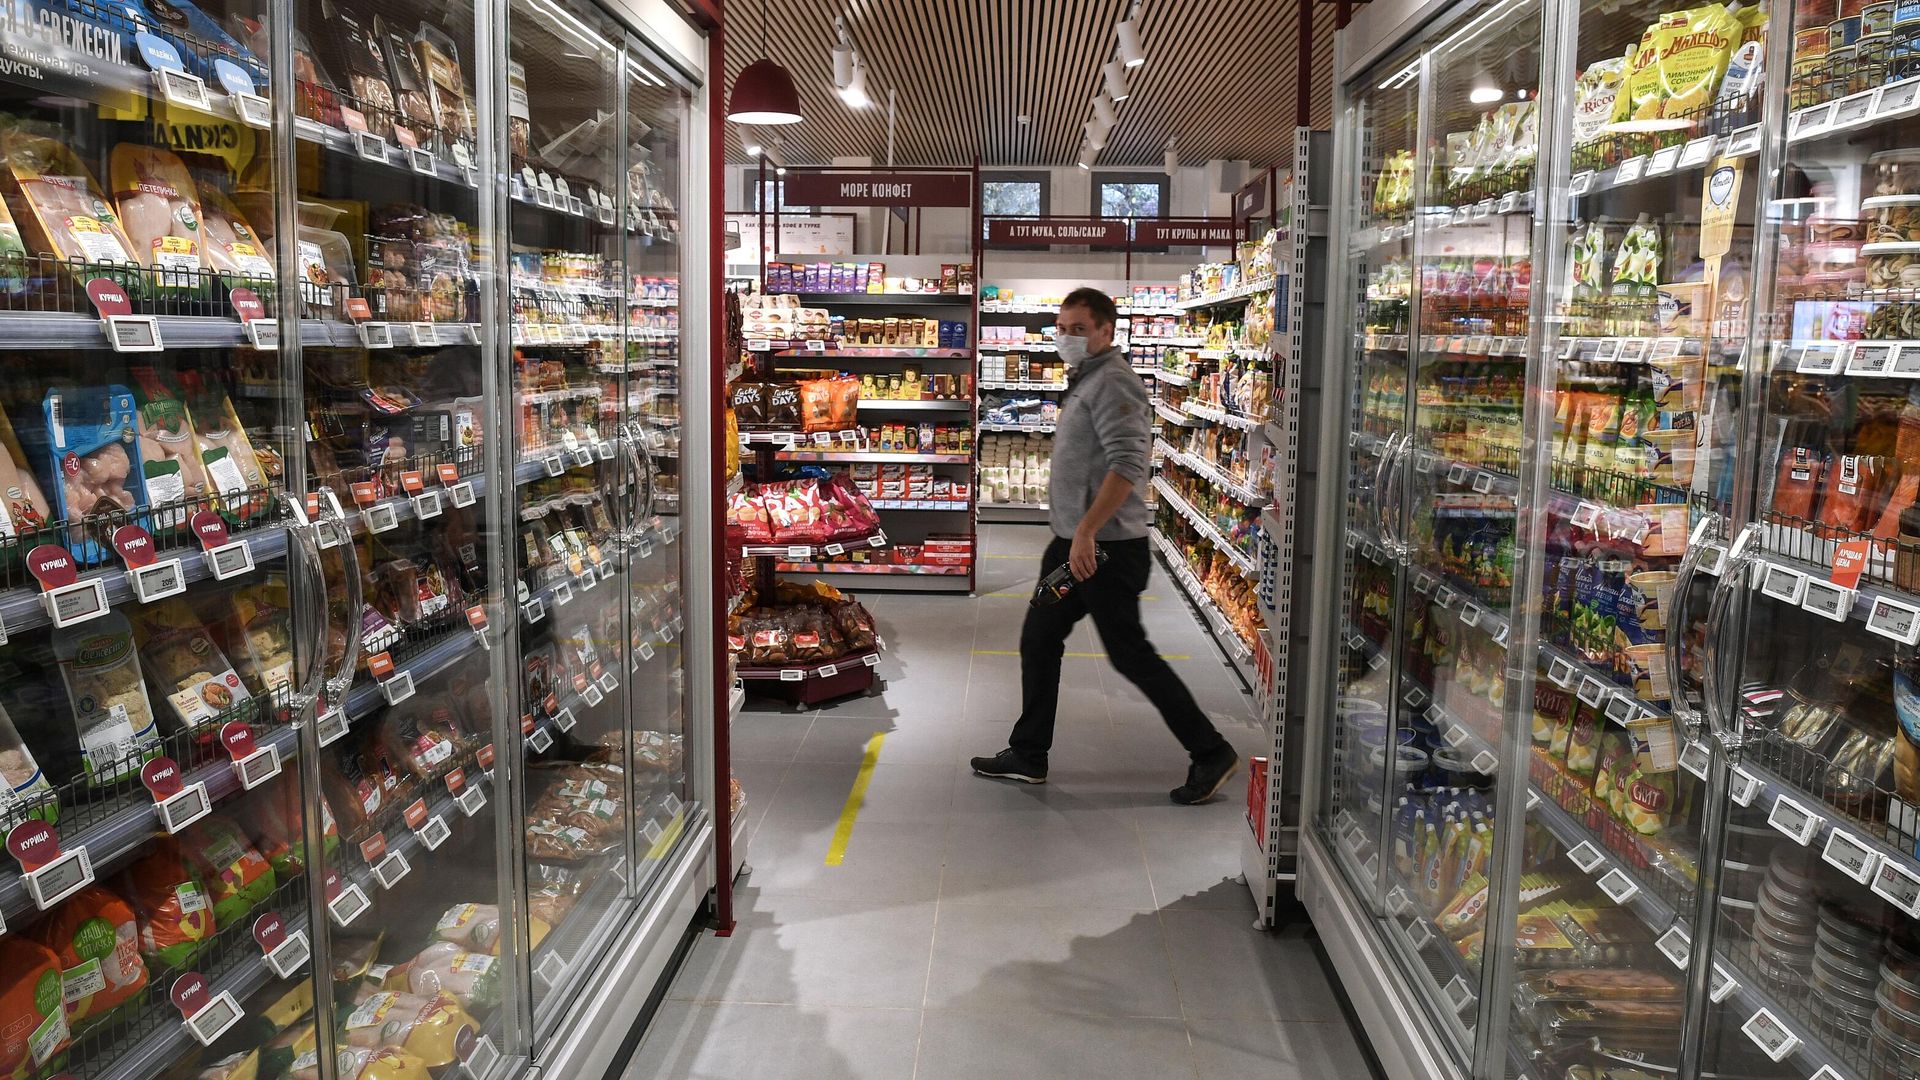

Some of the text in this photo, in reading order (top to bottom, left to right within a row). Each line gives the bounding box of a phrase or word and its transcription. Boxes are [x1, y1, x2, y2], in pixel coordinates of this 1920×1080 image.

[40, 8, 126, 67] СВЕЖЕСТИ.
[1666, 66, 1713, 79] ЛИМОННЫМ
[1671, 75, 1699, 85] СОКОМ
[1584, 94, 1616, 113] Ricco
[138, 183, 180, 198] ПЕТЕЛИНКА
[841, 183, 912, 198] МОРЕ КОНФЕТ
[1009, 226, 1106, 239] А ТУТ МУКА, СОЛЬ/САХАР
[1157, 228, 1169, 239] ТУТ
[1172, 228, 1199, 239] КРУПЫ
[1201, 228, 1207, 240] И
[99, 293, 124, 303] КУРИЦА
[239, 300, 259, 309] КУРИЦА
[734, 387, 758, 397] Lucky
[734, 393, 761, 405] DAYS
[774, 389, 794, 398] Lucky
[771, 394, 797, 406] DAYS
[201, 523, 221, 534] КУРИЦА
[124, 536, 148, 551] КУРИЦА
[1838, 548, 1863, 560] ЛУЧШАЯ
[40, 557, 69, 572] КУРИЦА
[1835, 558, 1850, 568] ЦЕНА
[229, 729, 248, 745] КУРИЦА
[151, 766, 174, 783] КУРИЦА
[1633, 784, 1660, 807] СКИТ
[20, 830, 50, 852] КУРИЦА
[80, 923, 108, 943] НАША
[261, 920, 280, 939] КУРИЦА
[81, 937, 113, 957] ПТИЧКА
[180, 980, 202, 1002] КУРИЦА
